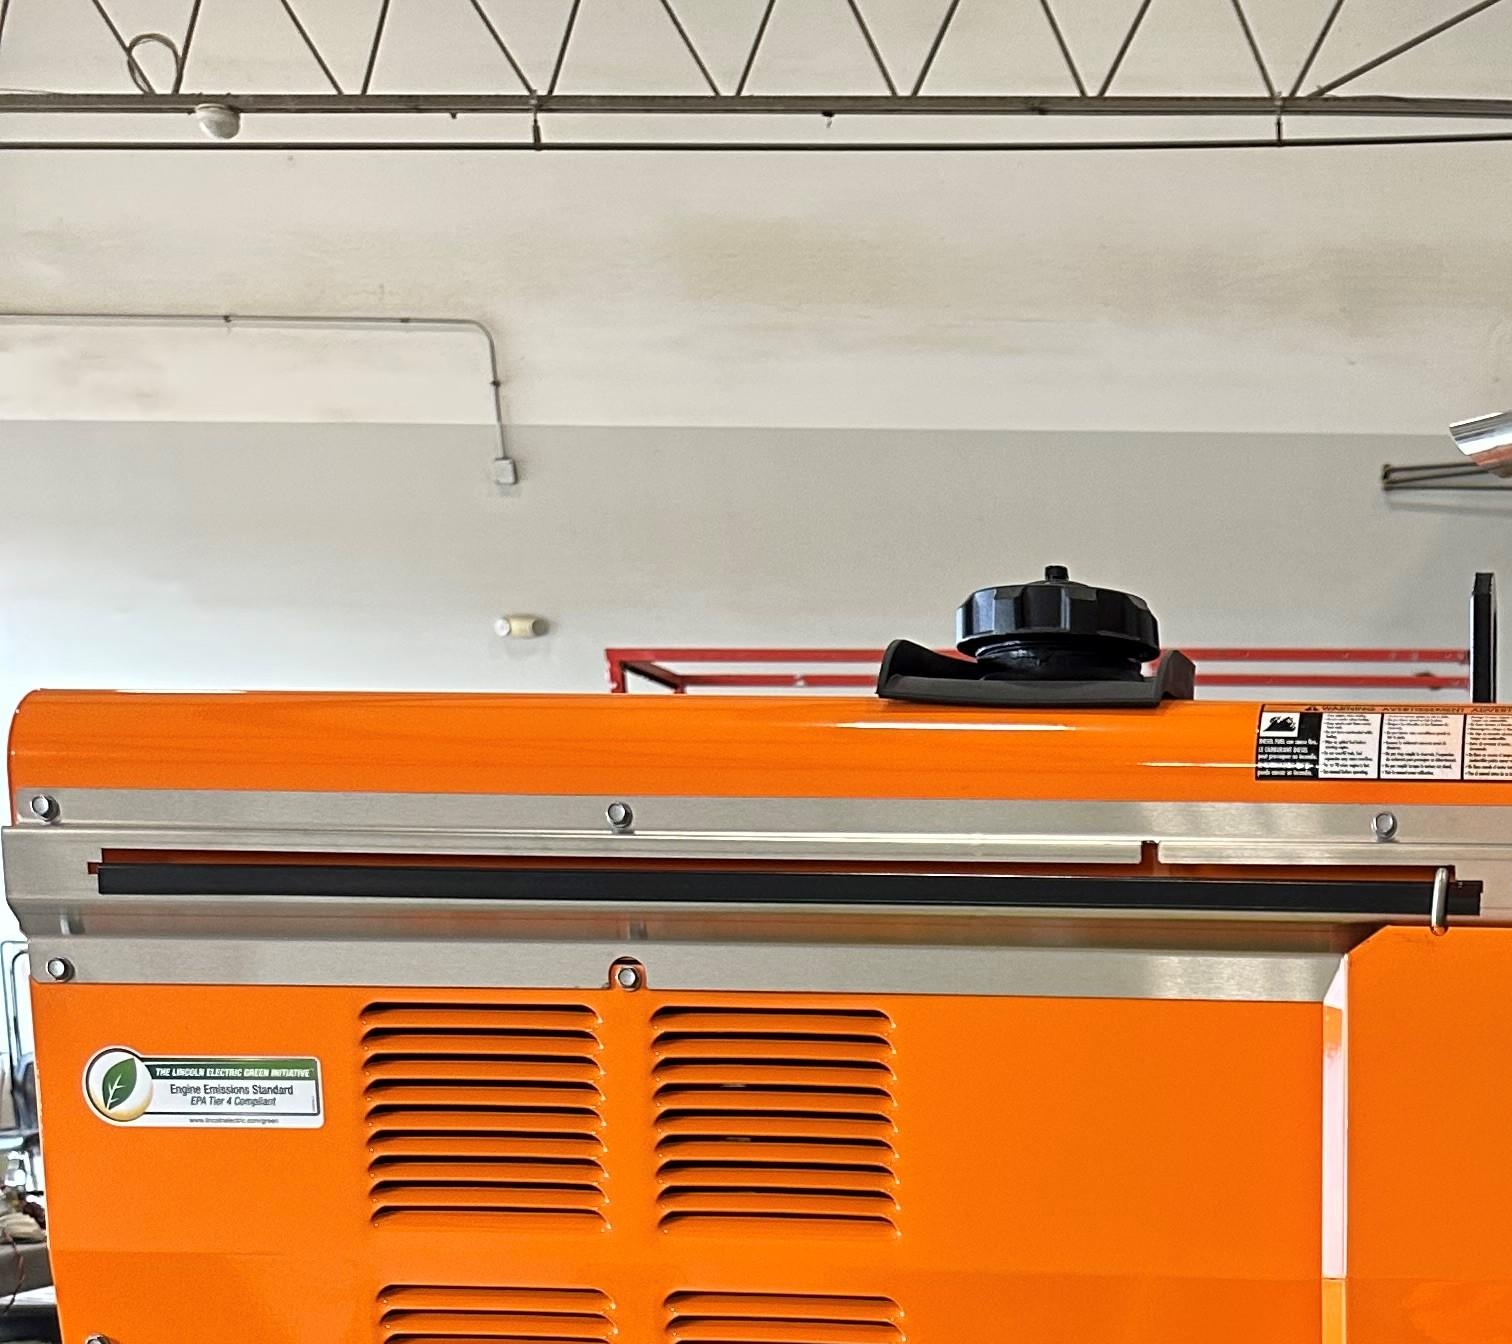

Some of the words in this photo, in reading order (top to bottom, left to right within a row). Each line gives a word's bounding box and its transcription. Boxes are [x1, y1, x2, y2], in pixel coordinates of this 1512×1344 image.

[155, 1068, 171, 1077] THE
[172, 1068, 205, 1077] LINCOLN
[206, 1068, 242, 1077] ELECTRIC
[170, 1084, 201, 1096] Engine
[204, 1084, 250, 1095] Emissions
[252, 1084, 294, 1095] Standard
[190, 1097, 207, 1106] EPA
[208, 1097, 225, 1106] Tier
[226, 1097, 232, 1106] 4
[234, 1097, 276, 1107] Compliant
